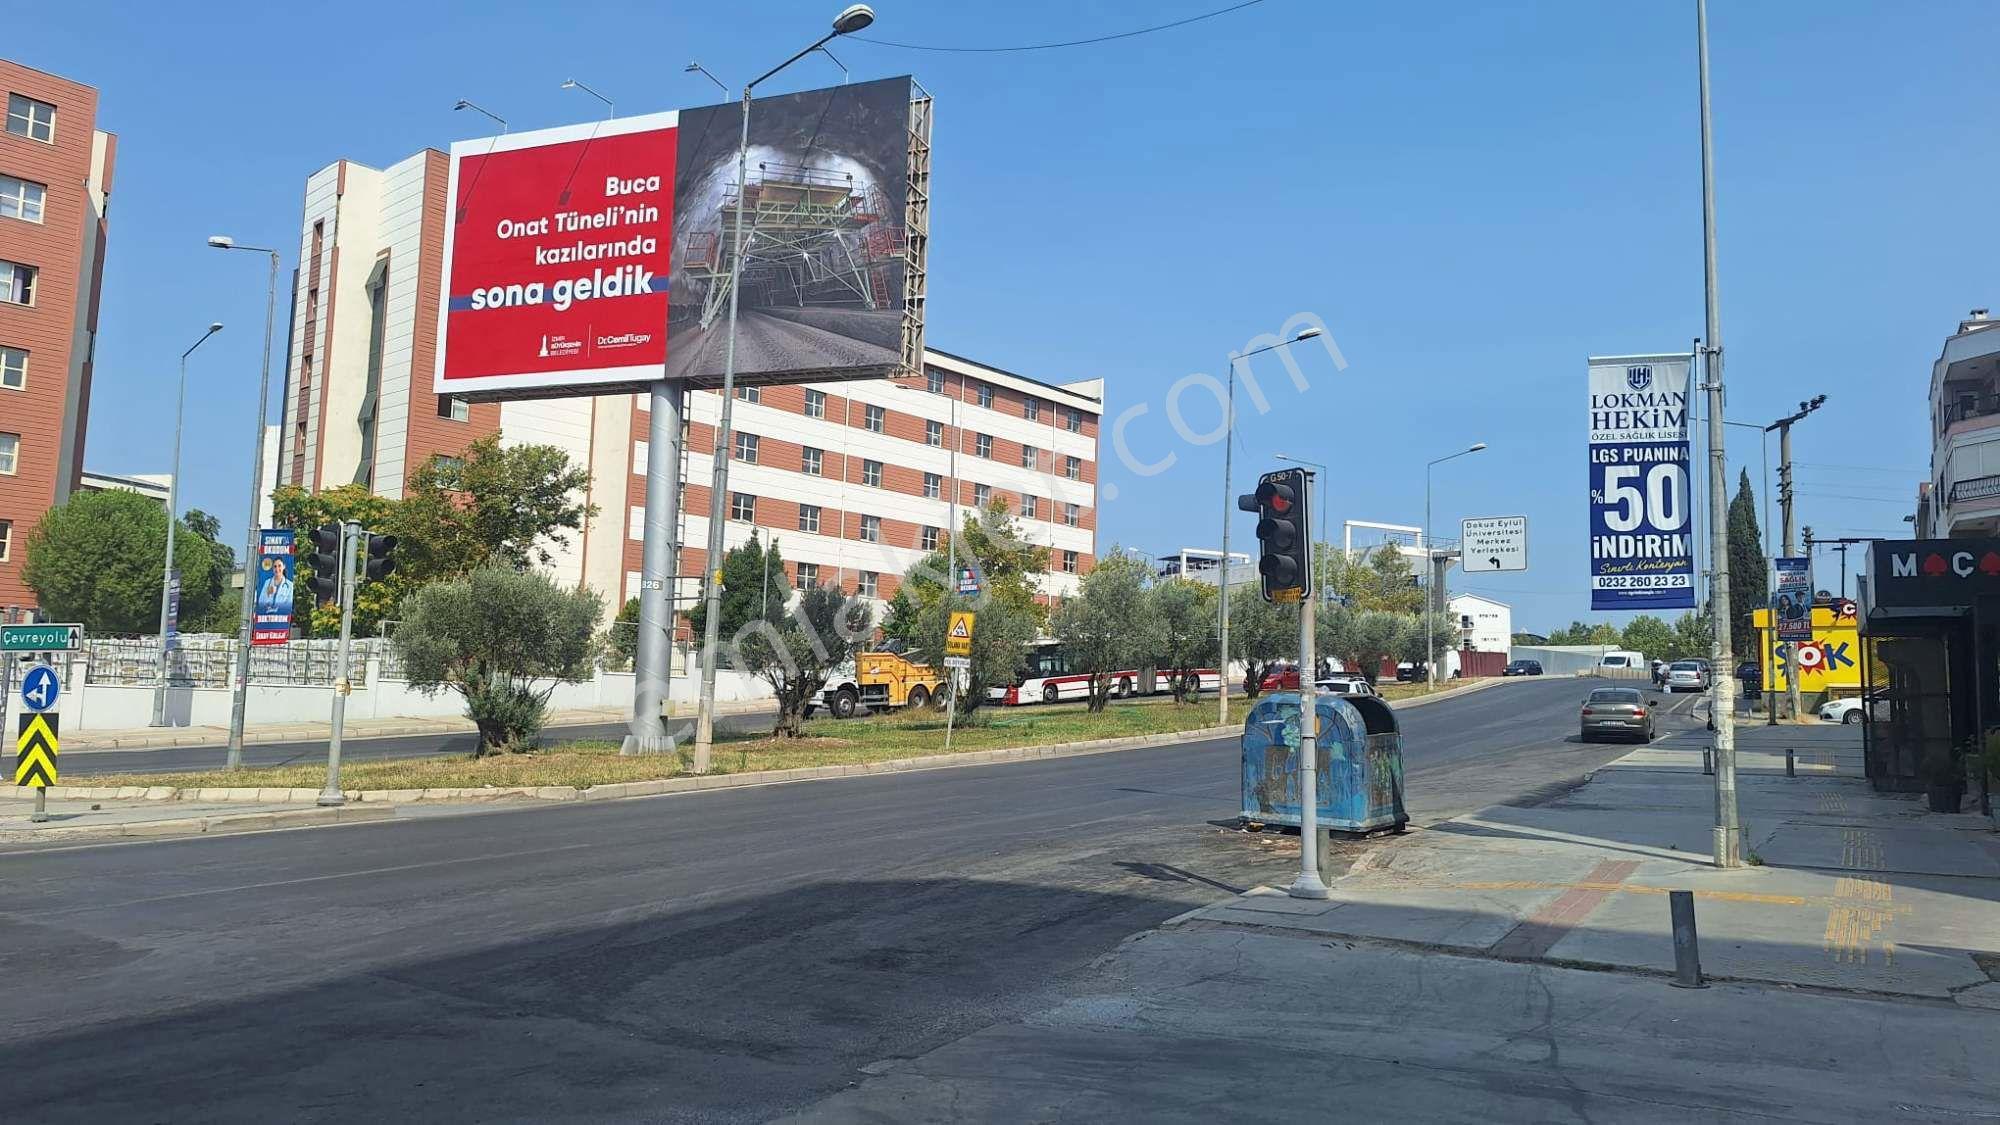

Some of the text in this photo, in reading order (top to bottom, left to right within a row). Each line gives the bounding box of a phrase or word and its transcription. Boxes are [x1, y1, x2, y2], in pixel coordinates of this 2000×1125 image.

[605, 176, 660, 196] Buca
[497, 217, 548, 239] Onat
[535, 235, 656, 265] kazılarında
[472, 265, 654, 311] sona geldik
[1592, 391, 1688, 409] LOKMAN
[1592, 432, 1617, 441] ÖZEL
[1620, 431, 1656, 441] SAĞLIK
[1592, 446, 1690, 463] LGS PUANINA
[1466, 529, 1523, 537] Üniversitesi
[1470, 546, 1519, 554] Yerleşkesi
[1599, 575, 1686, 588] 0232 260 23 23
[3, 630, 67, 646] Çevreyolu
